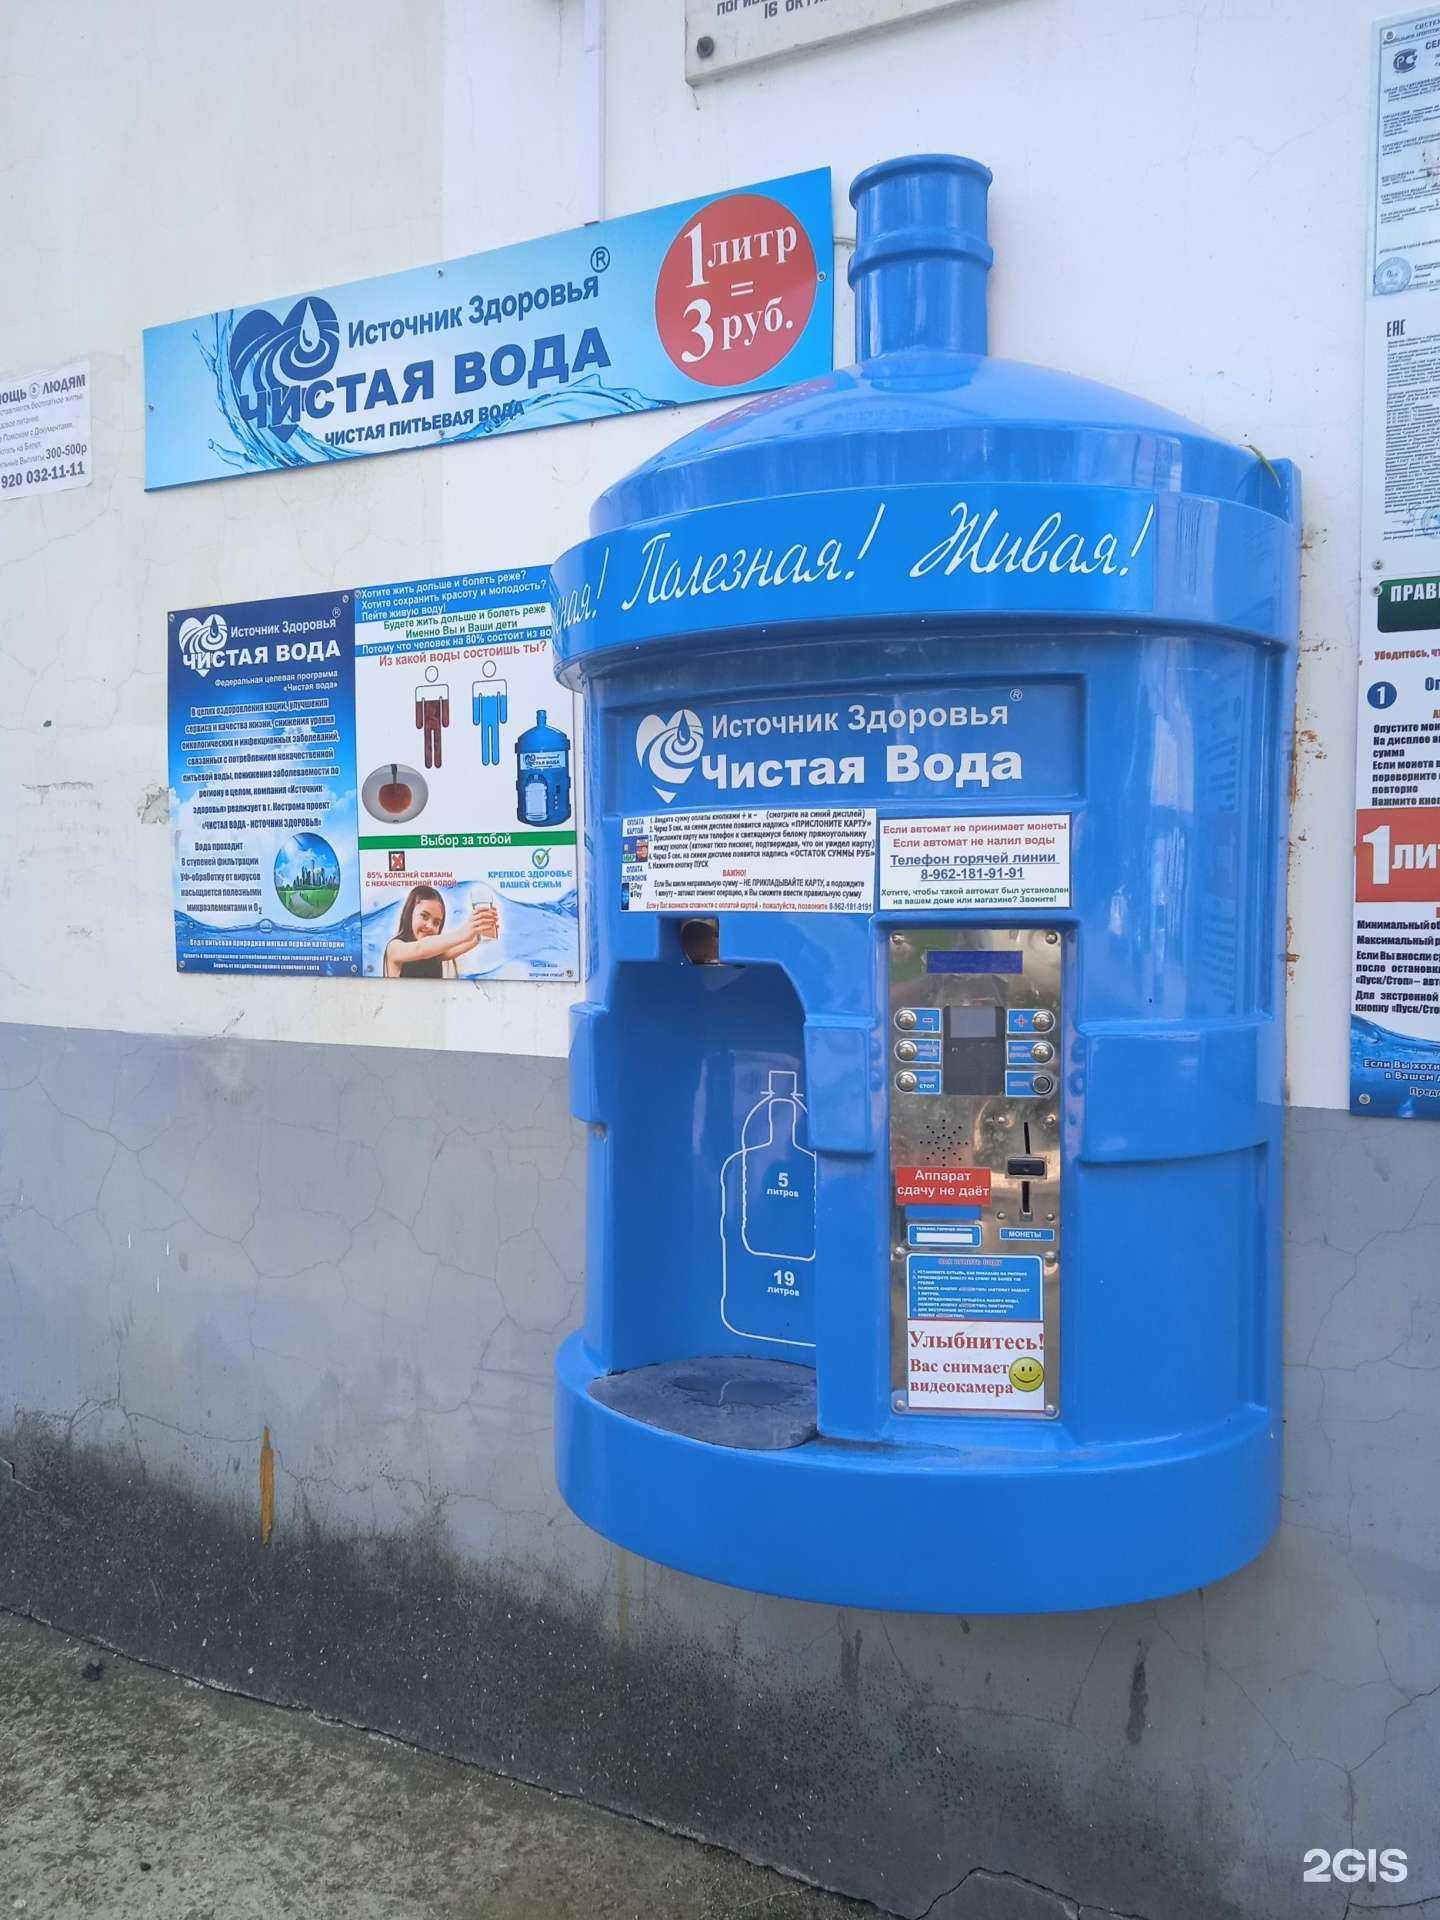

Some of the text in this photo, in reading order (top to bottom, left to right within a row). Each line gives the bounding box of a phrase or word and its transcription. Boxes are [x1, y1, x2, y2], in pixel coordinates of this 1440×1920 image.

[707, 225, 797, 268] литр
[349, 276, 600, 348] Источник Здоровья
[681, 296, 793, 363] 3 руб.
[239, 327, 611, 428] ЧИСТАЯ ВОДА
[0, 374, 86, 405] ОЩЬ ЛЮДЯМ
[325, 400, 525, 447] ЧИСТАЯ ПИТЬЕВАЯ ВОДА
[45, 443, 87, 461] 300-500р
[1, 472, 22, 488] 920
[27, 461, 85, 483] 032-11-11
[621, 502, 886, 610] Полезная!
[909, 501, 1154, 579] Живая!
[361, 570, 527, 599] Хотите жить дольше и болеть реже?
[361, 580, 547, 610] Хотите сохранить красоту и молодость?
[1390, 583, 1440, 602] ПРАВ
[361, 605, 446, 622] Пейте живую воду!
[383, 605, 546, 631] Будете жить дольше и болеть реже
[231, 618, 336, 638] Источник Здоровья
[405, 620, 518, 639] Именно Вы и Ваши дети
[362, 628, 552, 655] Потому что человек на 80% состоит из во
[183, 640, 341, 670] ЧИСТАЯ ВОДА
[379, 640, 547, 667] Из какой воды состоишь ты?
[215, 670, 338, 687] Федеральная целевая программа
[1377, 686, 1386, 705] 1
[712, 703, 1009, 740] Источник Здоровья
[1374, 724, 1419, 734] Опустите
[1374, 736, 1430, 746] На дисплее
[1373, 749, 1405, 758] сумма
[702, 744, 1022, 790] Чистая Вода
[1373, 761, 1396, 770] Если
[1372, 785, 1419, 794] повторно
[1372, 797, 1417, 806] Нажмите
[883, 822, 1067, 834] Если автомат не принимает монеты
[420, 833, 512, 847] Выбор за тобой
[893, 836, 1055, 848] Если автомат не налил воды
[890, 851, 1056, 867] Телефон горячей линии
[1362, 825, 1390, 885] 1
[384, 870, 418, 879] БОЛЕЗНЕЙ
[420, 871, 453, 879] СВЯЗАНЫ
[488, 870, 573, 879] КРЕПКОЕ ЗДОРОВЬЕ
[920, 867, 1024, 880] 8-962-181-91-91
[371, 878, 457, 888] НЕКАЧЕСТВЕННОЙ ВОДОЙ
[500, 879, 562, 889] ВАШЕЙ СЕМЬИ
[913, 887, 939, 896] чтобы
[941, 886, 964, 895] такой
[1001, 886, 1019, 895] был
[1021, 887, 1070, 895] установлен
[893, 897, 903, 905] на
[904, 897, 932, 905] вашем
[933, 896, 955, 905] доме
[957, 896, 972, 905] или
[974, 895, 1018, 904] магазине?
[1357, 920, 1430, 930] Минимальный
[1356, 935, 1435, 946] Максимальный
[1356, 950, 1380, 960] Если
[1380, 951, 1394, 960] Вы
[1356, 963, 1386, 973] после
[1355, 990, 1375, 1001] Для
[1355, 1003, 1389, 1014] кнопку
[1363, 1059, 1411, 1069] Если Вы
[1395, 1072, 1434, 1081] Вашем
[778, 1172, 788, 1187] 5
[914, 1170, 971, 1182] Аппарат
[767, 1188, 799, 1197] литров
[897, 1185, 989, 1198] сдачу не даёт
[1008, 1231, 1042, 1239] МОНЕТЫ
[774, 1270, 795, 1286] 19
[767, 1287, 800, 1296] литров
[910, 1330, 1045, 1351] Улыбнитесь!
[910, 1358, 1009, 1374] Вас снимает
[910, 1381, 1013, 1397] видеокамера
